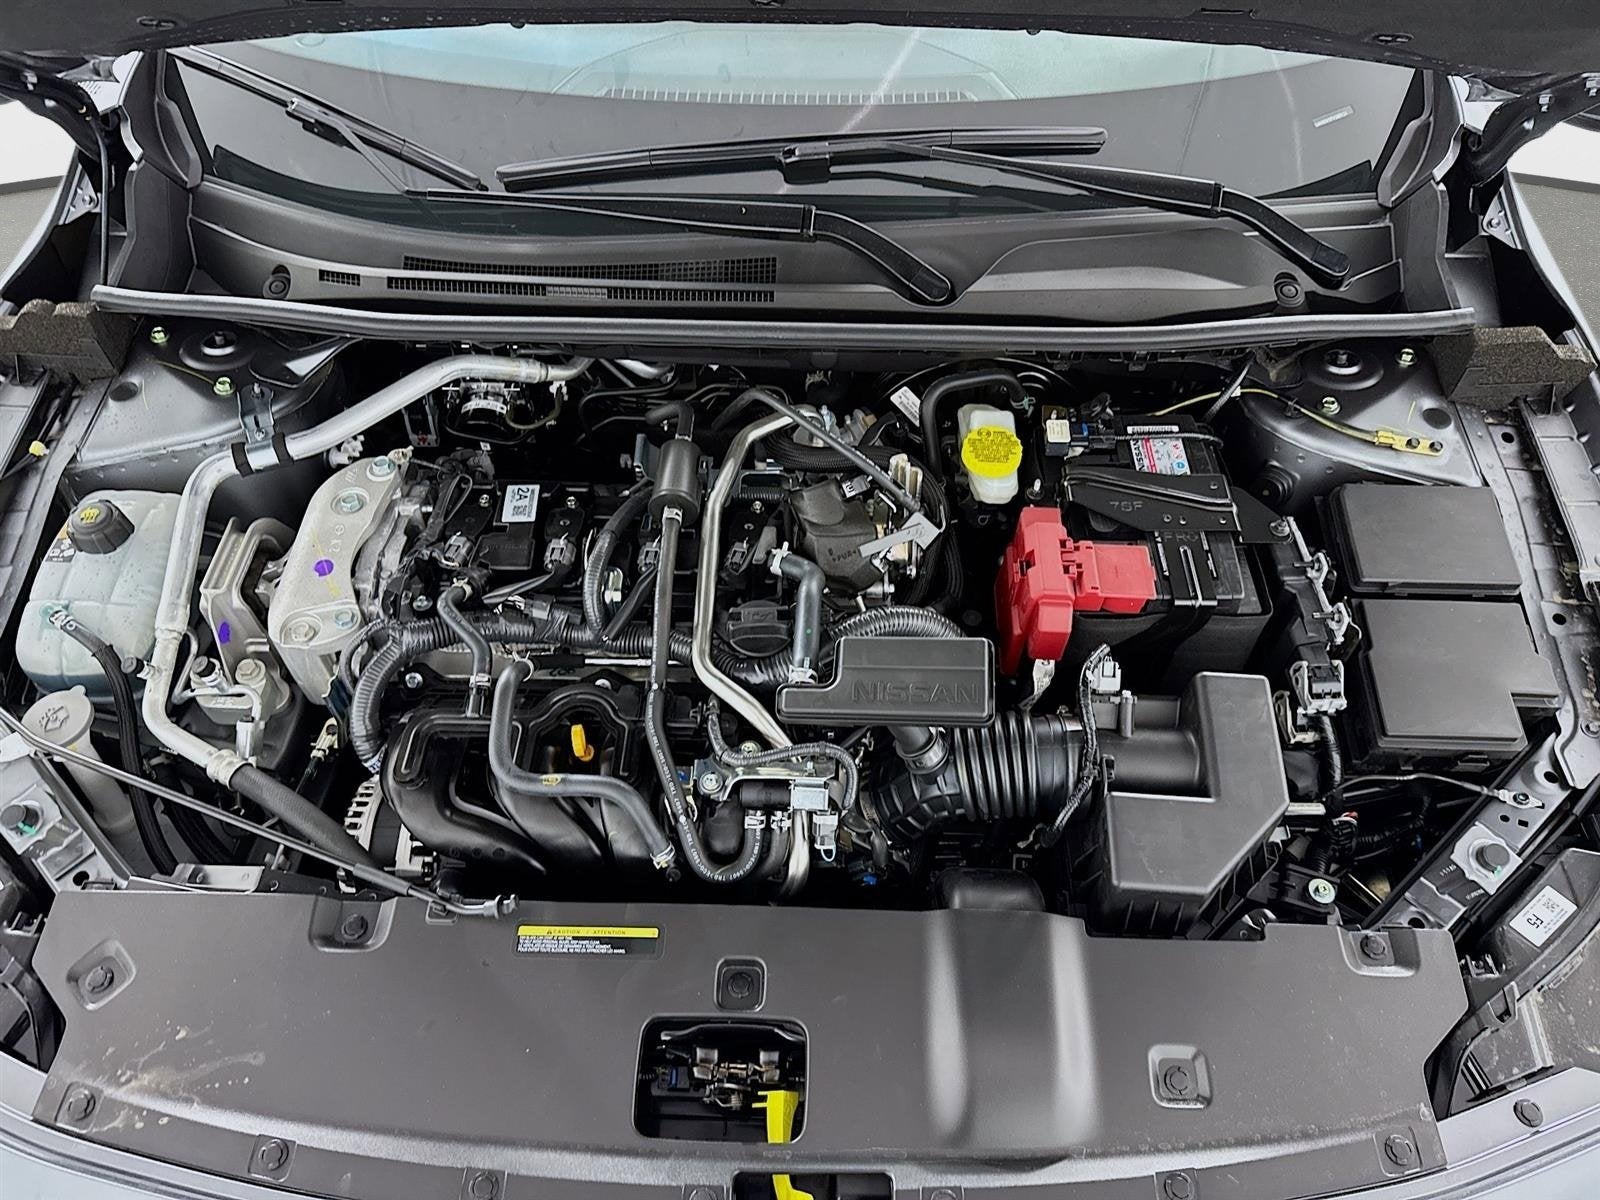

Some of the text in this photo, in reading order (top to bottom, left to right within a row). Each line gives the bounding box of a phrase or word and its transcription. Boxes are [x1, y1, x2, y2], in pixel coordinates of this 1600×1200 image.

[516, 487, 530, 502] 2A
[851, 679, 979, 705] NISSAN
[1526, 913, 1544, 929] F5
